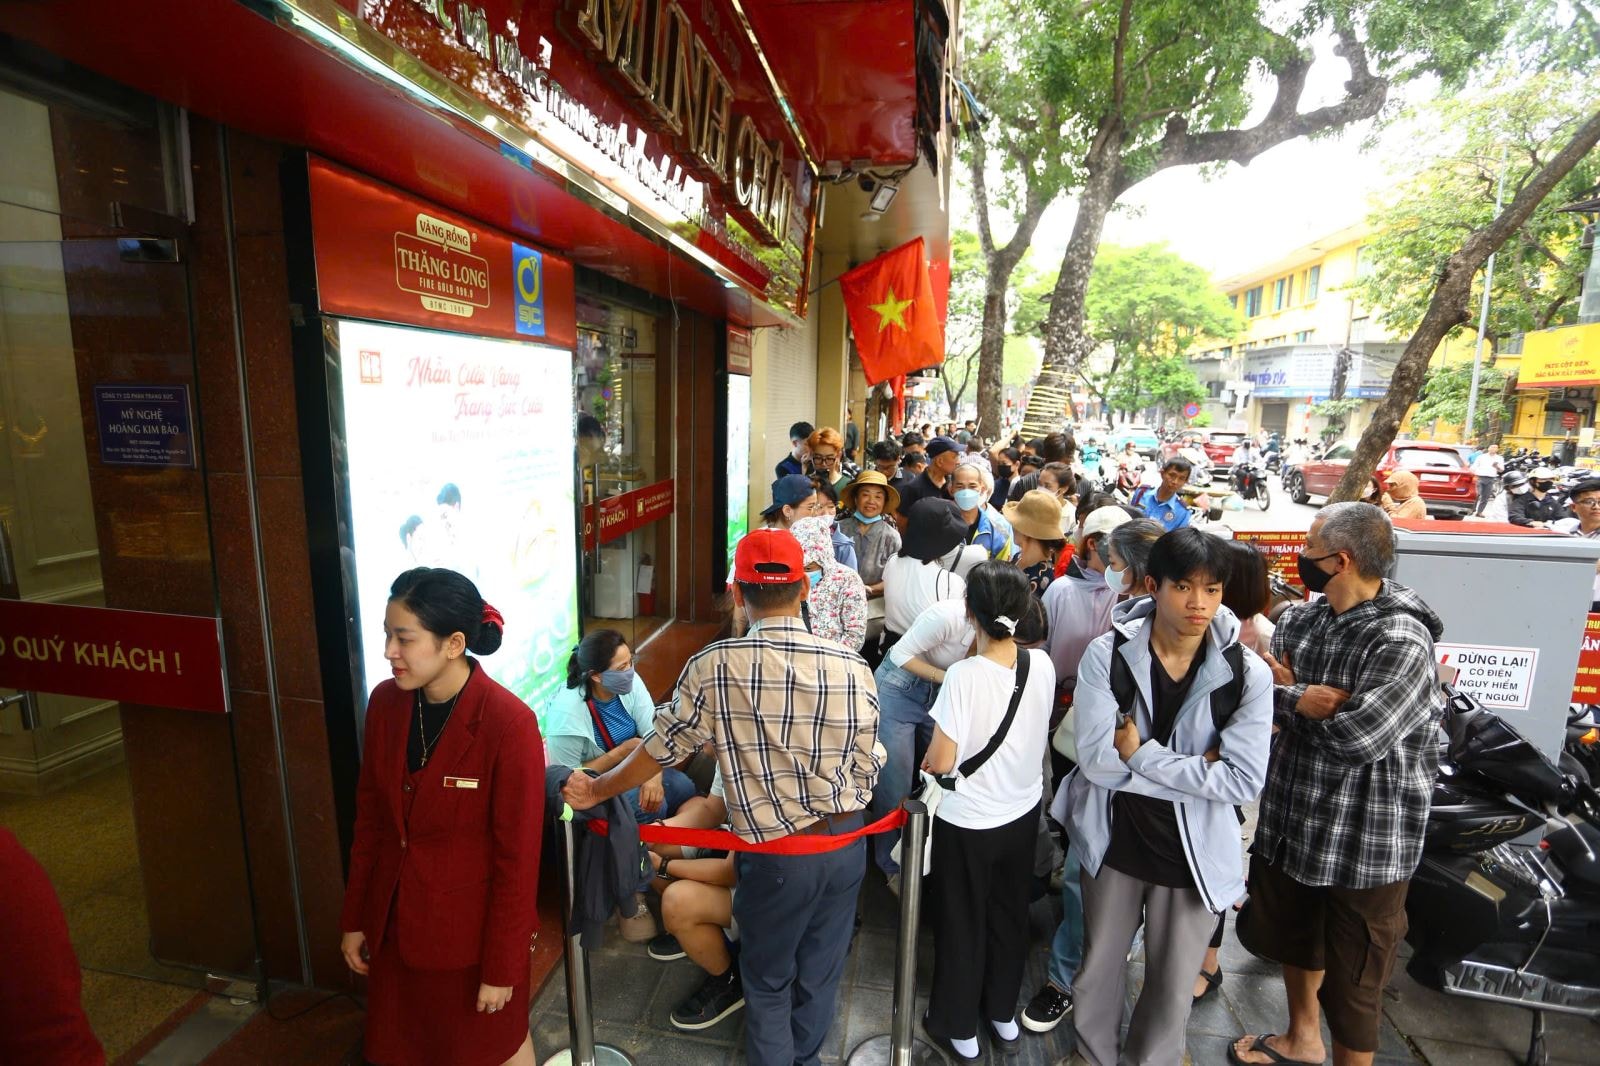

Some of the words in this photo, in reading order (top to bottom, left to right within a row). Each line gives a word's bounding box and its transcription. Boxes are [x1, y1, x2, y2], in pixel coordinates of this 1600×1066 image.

[419, 219, 444, 238] VÀNG
[445, 227, 469, 247] RỒNG
[398, 247, 450, 279] THĂNG
[453, 263, 487, 289] LONG
[419, 276, 434, 290] FINE
[437, 281, 453, 294] GOLD
[142, 425, 159, 434] KIM
[13, 635, 65, 662] QUÝ
[73, 641, 167, 673] KHÁCH
[174, 652, 183, 675] !
[1458, 651, 1497, 666] DỪNG
[1501, 656, 1529, 669] LẠI!
[1459, 679, 1490, 688] NGUY
[1491, 679, 1518, 690] HIỂM
[1485, 692, 1519, 702] NGƯỜI
